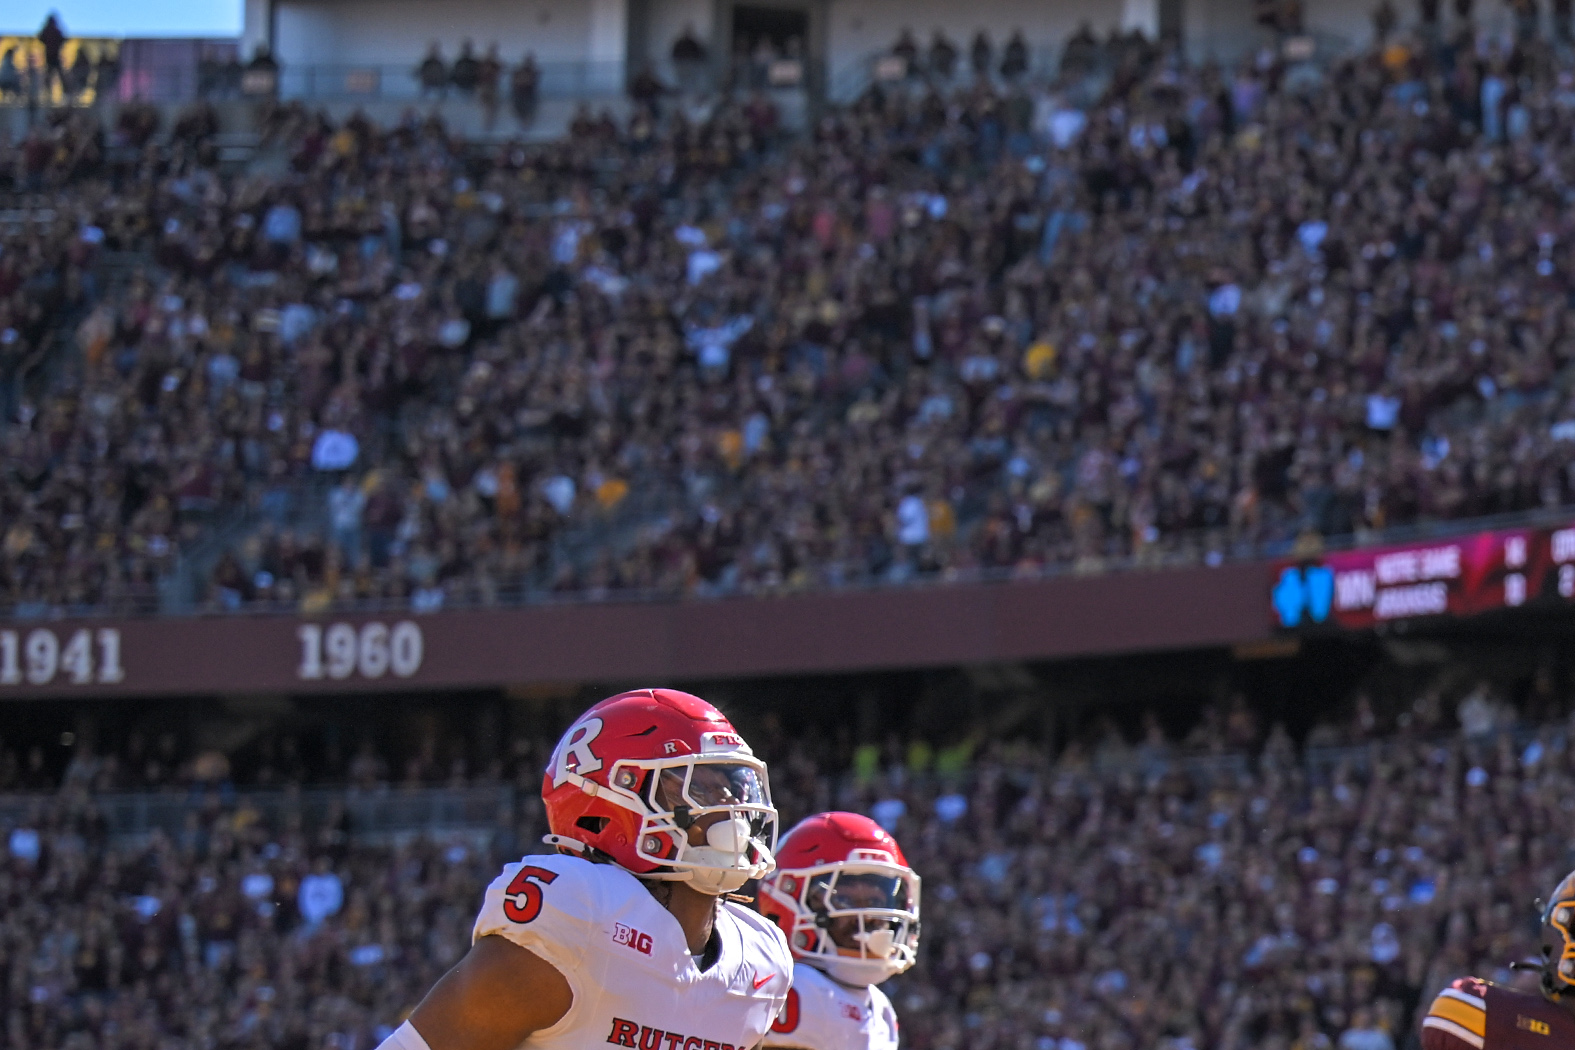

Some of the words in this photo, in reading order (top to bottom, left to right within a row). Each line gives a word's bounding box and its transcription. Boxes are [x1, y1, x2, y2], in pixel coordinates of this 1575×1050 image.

[0, 628, 124, 685] 1941
[299, 620, 422, 679] 1960
[552, 716, 604, 790] R
[663, 741, 677, 754] R
[502, 865, 560, 924] 5
